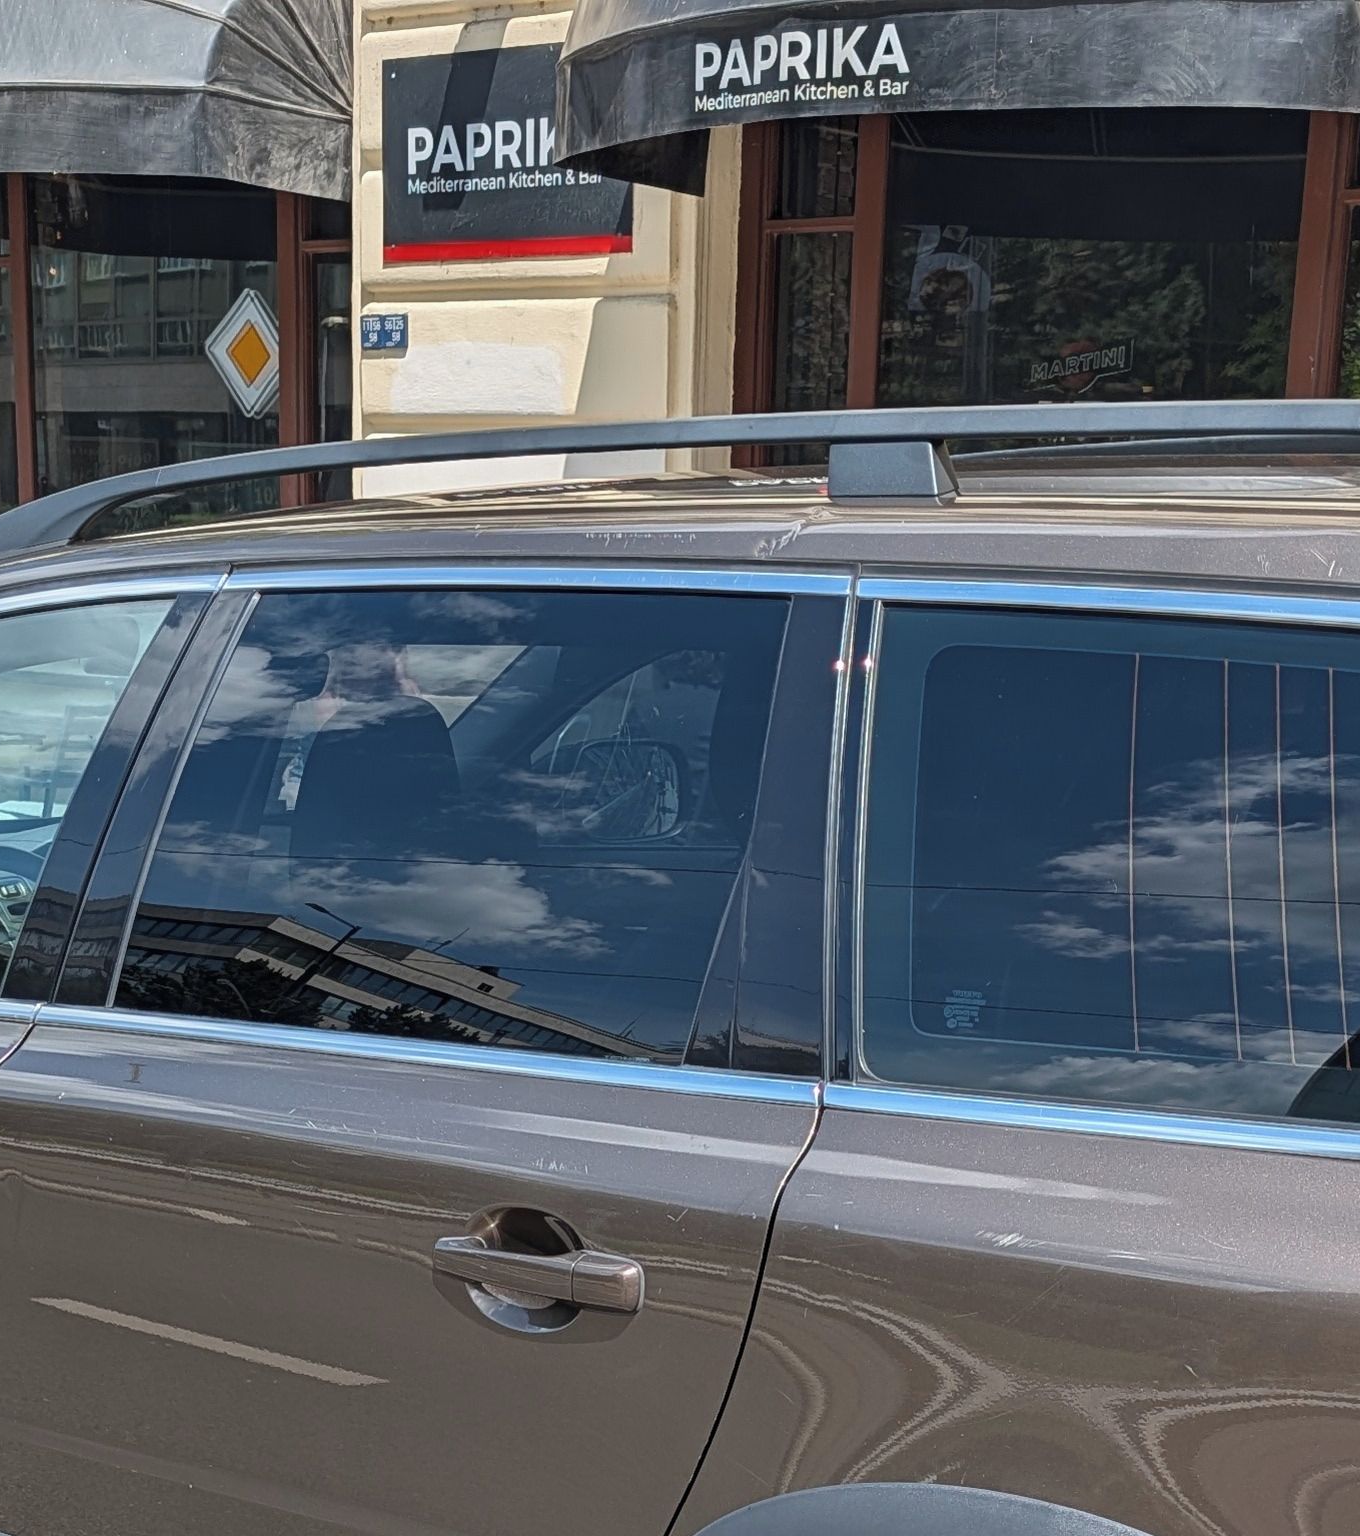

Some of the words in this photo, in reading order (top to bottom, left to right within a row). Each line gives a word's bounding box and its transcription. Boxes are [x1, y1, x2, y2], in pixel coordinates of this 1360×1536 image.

[695, 23, 911, 92] PAPRIKA
[694, 88, 790, 113] Mediterranean
[793, 80, 859, 101] Kitchen
[863, 79, 876, 97] &
[879, 78, 910, 97] Bar
[407, 117, 557, 175] PAPRIK
[407, 175, 505, 195] Mediterranean
[509, 170, 562, 189] Kitchen
[565, 169, 576, 185] &
[1030, 346, 1126, 382] MARTINI
